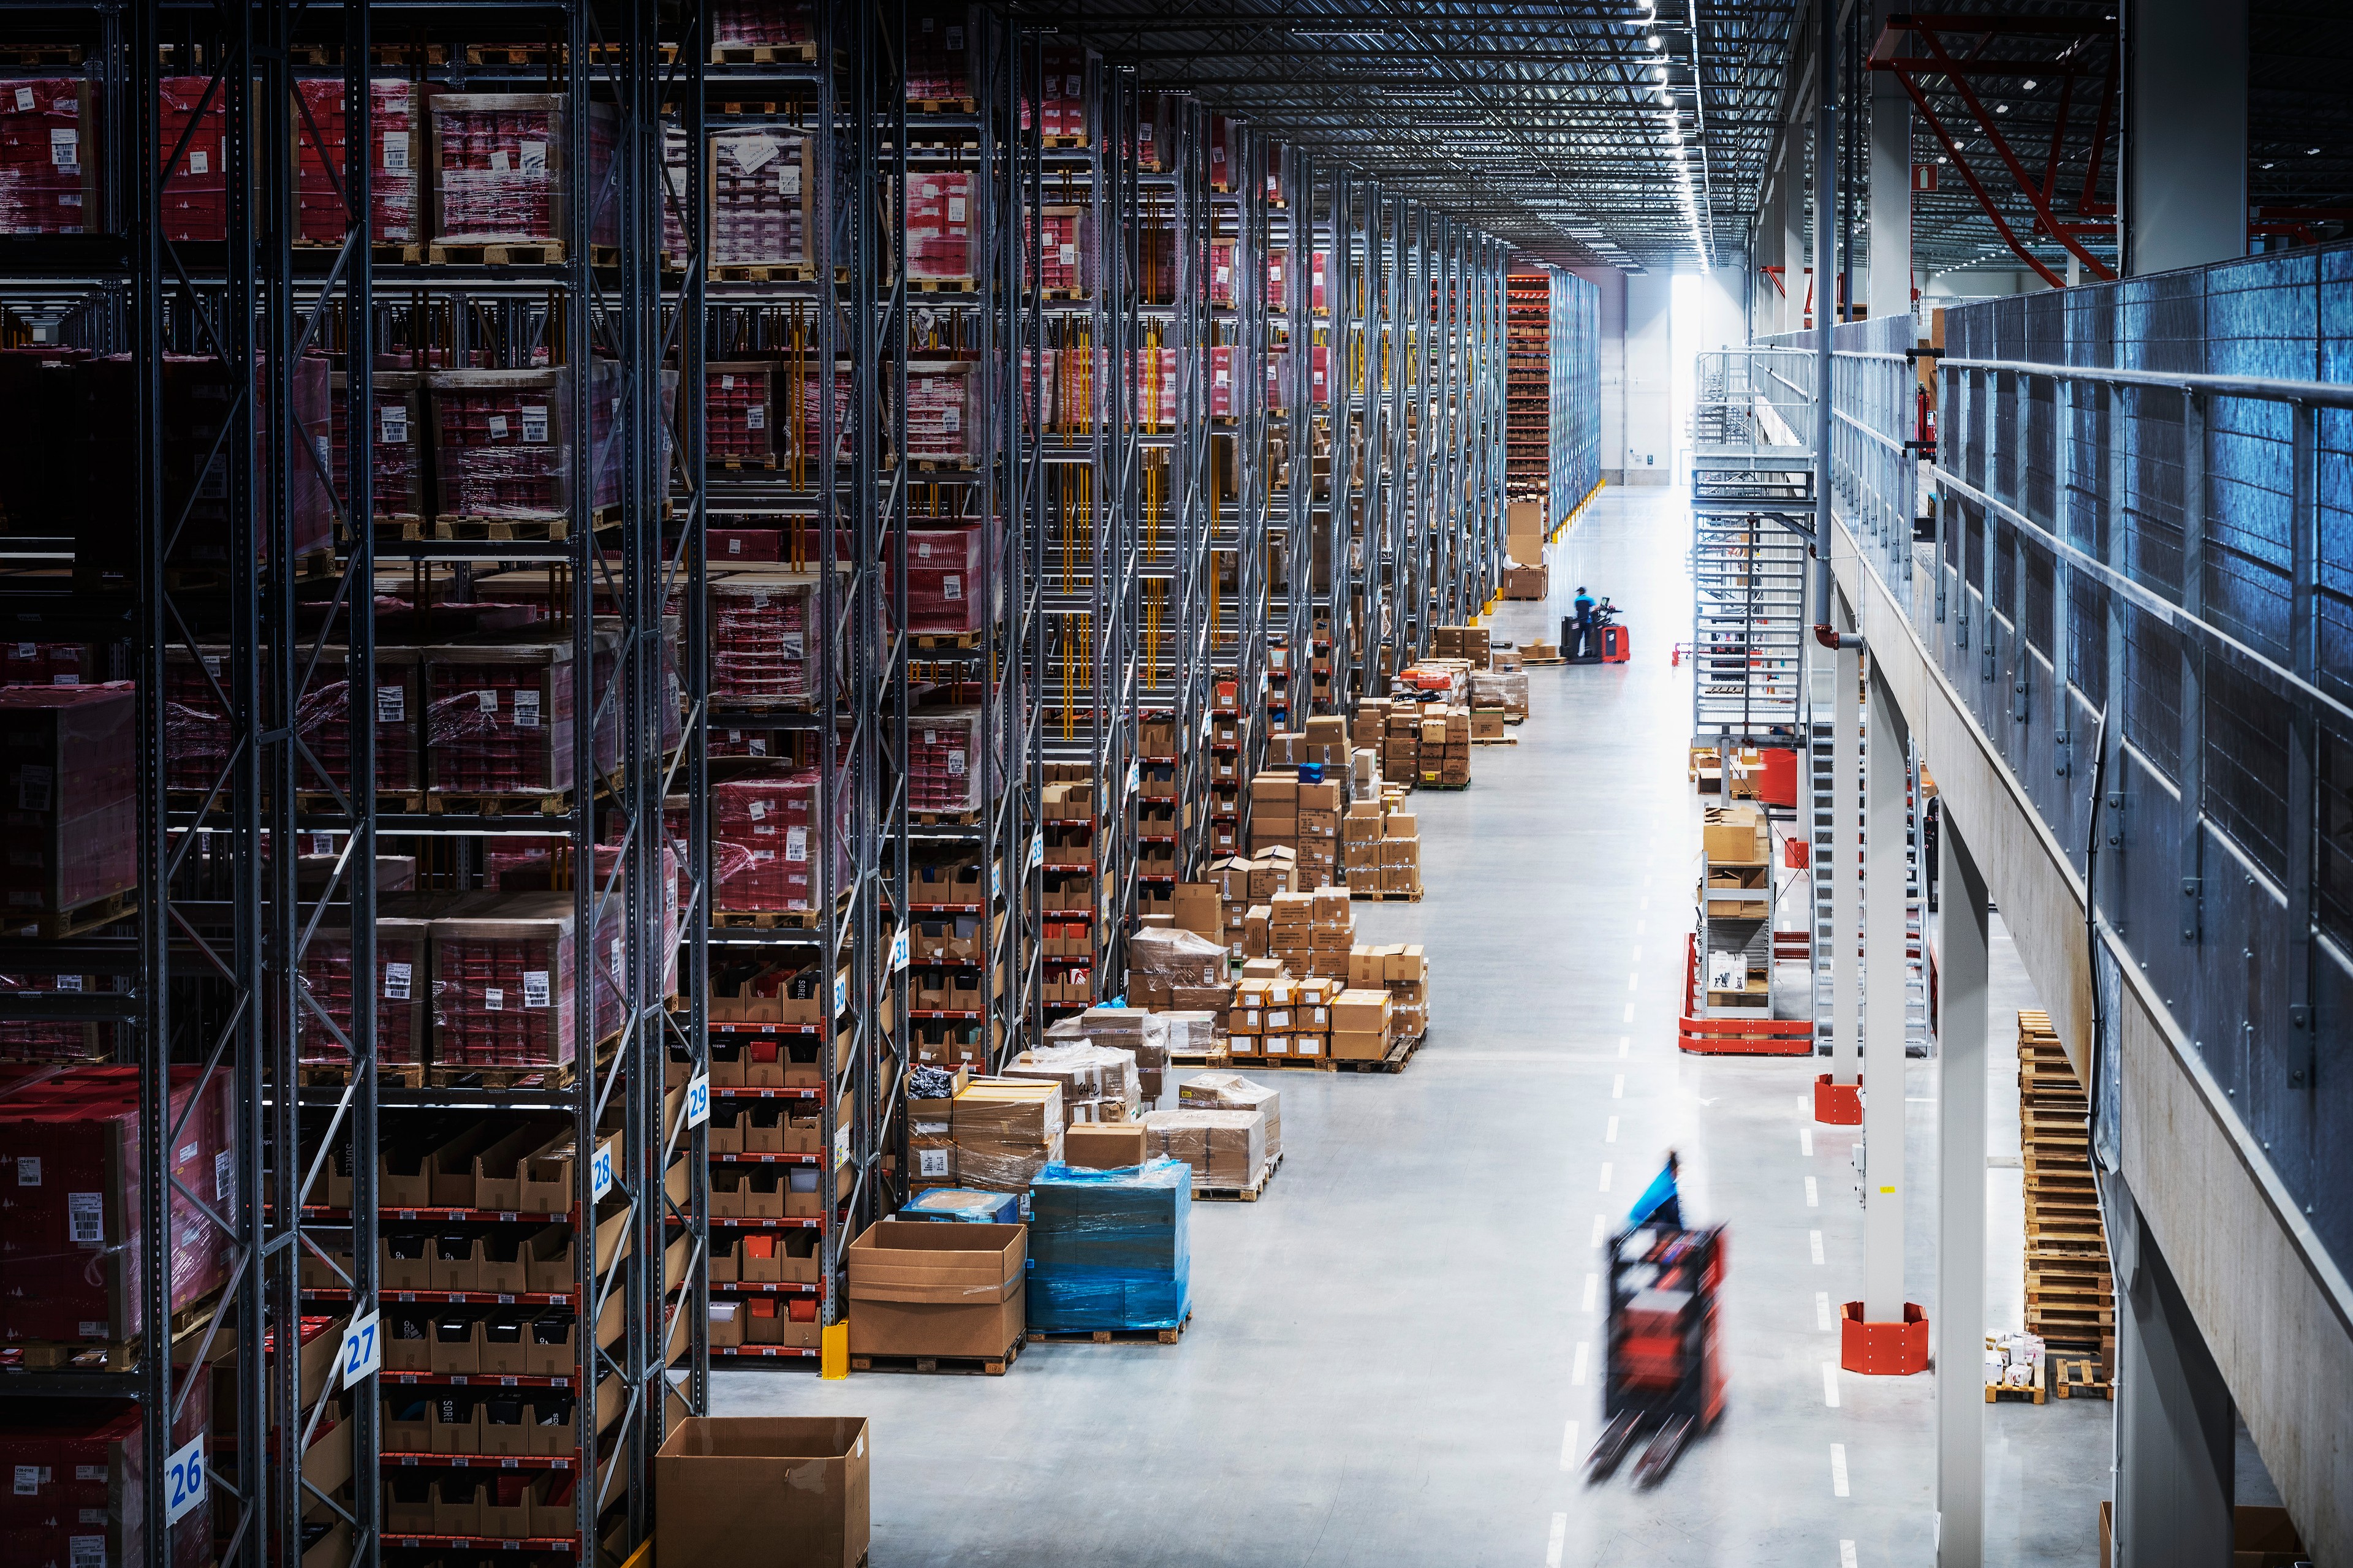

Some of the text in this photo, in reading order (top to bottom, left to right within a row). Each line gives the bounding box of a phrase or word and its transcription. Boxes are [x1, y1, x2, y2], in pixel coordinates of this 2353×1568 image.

[1205, 716, 1211, 732] 37
[1132, 769, 1138, 787] 35
[1033, 839, 1042, 861] 33
[993, 869, 999, 893] 32
[896, 937, 907, 964] 31
[836, 982, 844, 1009] 30
[690, 1084, 707, 1118] 29
[1077, 1082, 1101, 1096] 642
[594, 1153, 610, 1192] 28
[347, 1323, 375, 1375] 27
[443, 1400, 453, 1423] SORE
[171, 1450, 201, 1509] 26
